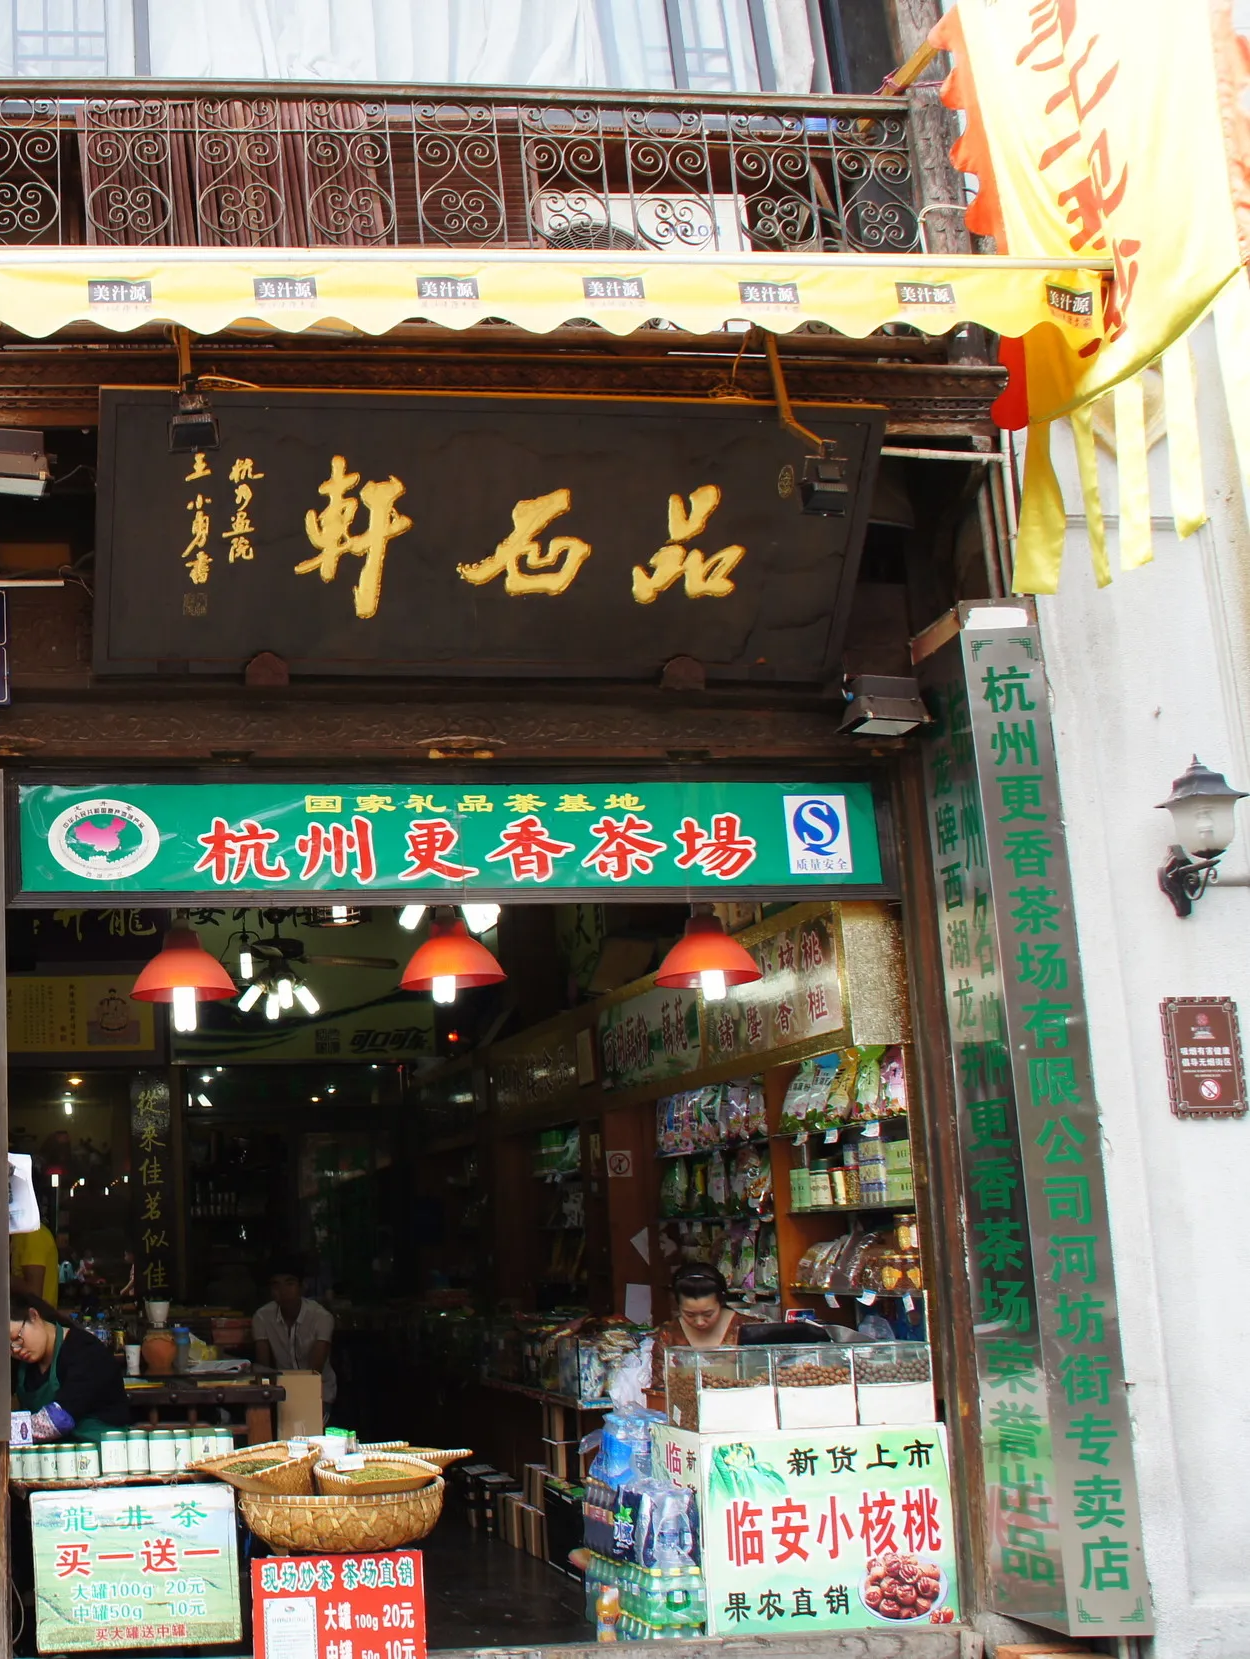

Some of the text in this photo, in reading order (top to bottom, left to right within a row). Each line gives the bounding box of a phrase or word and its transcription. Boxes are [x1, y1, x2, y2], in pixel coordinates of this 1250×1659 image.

[93, 283, 149, 302] 美汁源
[259, 279, 315, 299] 美汁源
[421, 278, 478, 299] 美汁源
[587, 279, 644, 299] 美汁源
[743, 284, 796, 304] 美汁源
[900, 283, 953, 304] 美汁源
[1049, 290, 1092, 314] 美汁源
[305, 793, 646, 813] 国家礼品茶基地
[194, 812, 757, 885] 杭州更香茶場
[795, 858, 848, 871] 质量安全
[982, 664, 1132, 1592] 杭州更香茶场有限公司河坊街专卖店
[964, 1094, 1056, 1586] 更香茶场荣誉出品
[665, 1441, 683, 1487] 临
[786, 1438, 935, 1477] 新货上市
[62, 1500, 208, 1532] 龍井茶
[725, 1487, 943, 1567] 临安小核桃
[56, 1538, 220, 1577] 买一送一
[262, 1556, 415, 1592] 现场炒茶 茶场直销
[166, 1580, 206, 1596] 20元
[324, 1602, 352, 1631] 大罐
[355, 1614, 379, 1631] 100g
[383, 1602, 415, 1629] 20元
[724, 1585, 850, 1622] 果农直销
[96, 1623, 187, 1641] 买大罐送中罐
